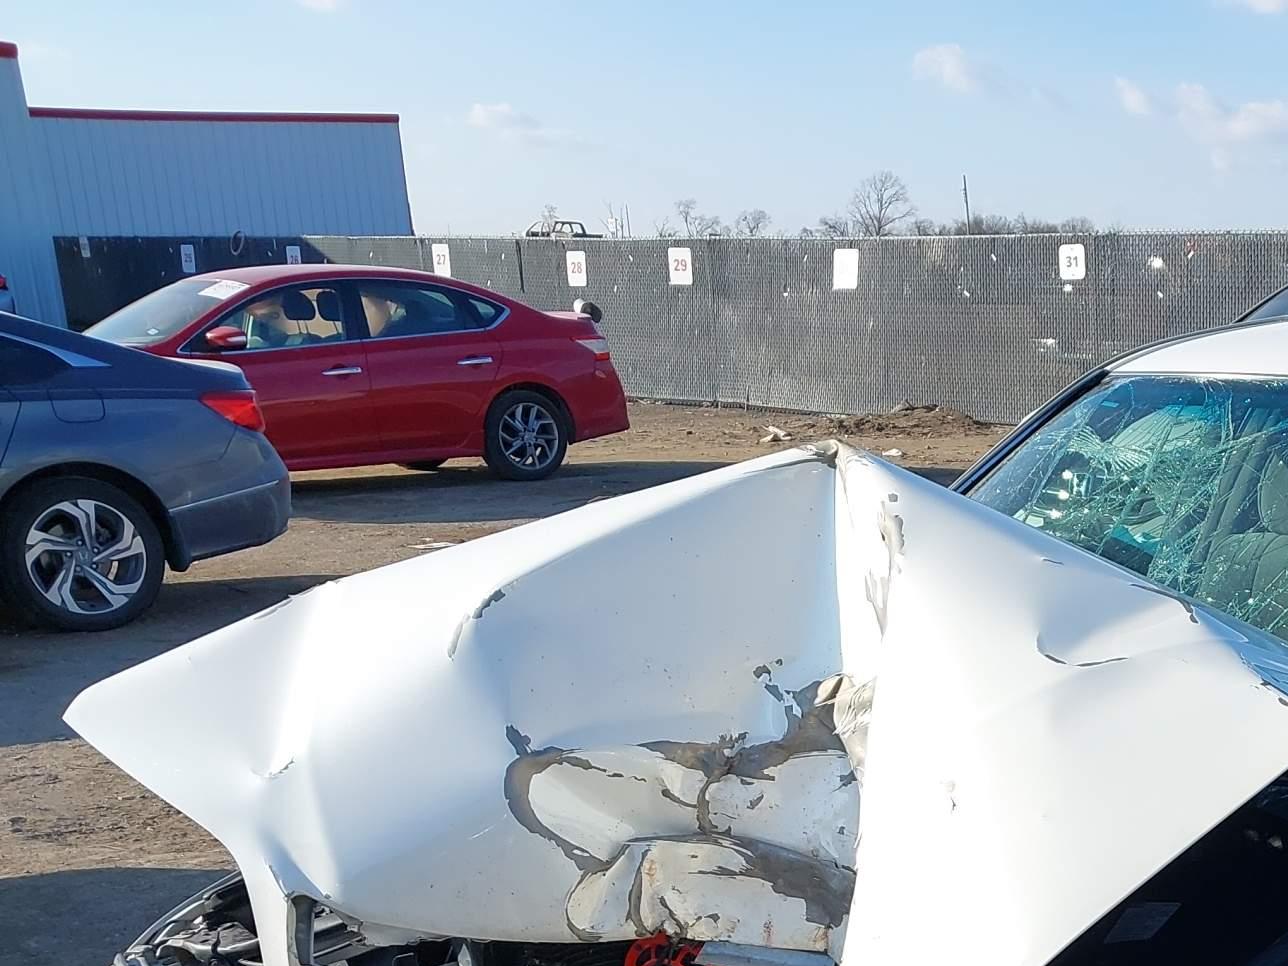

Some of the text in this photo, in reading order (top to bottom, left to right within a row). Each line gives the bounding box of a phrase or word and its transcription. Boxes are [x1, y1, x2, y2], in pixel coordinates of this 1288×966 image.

[436, 254, 446, 265] 27
[673, 258, 687, 272] 29
[1065, 256, 1078, 268] 31
[571, 262, 583, 274] 28
